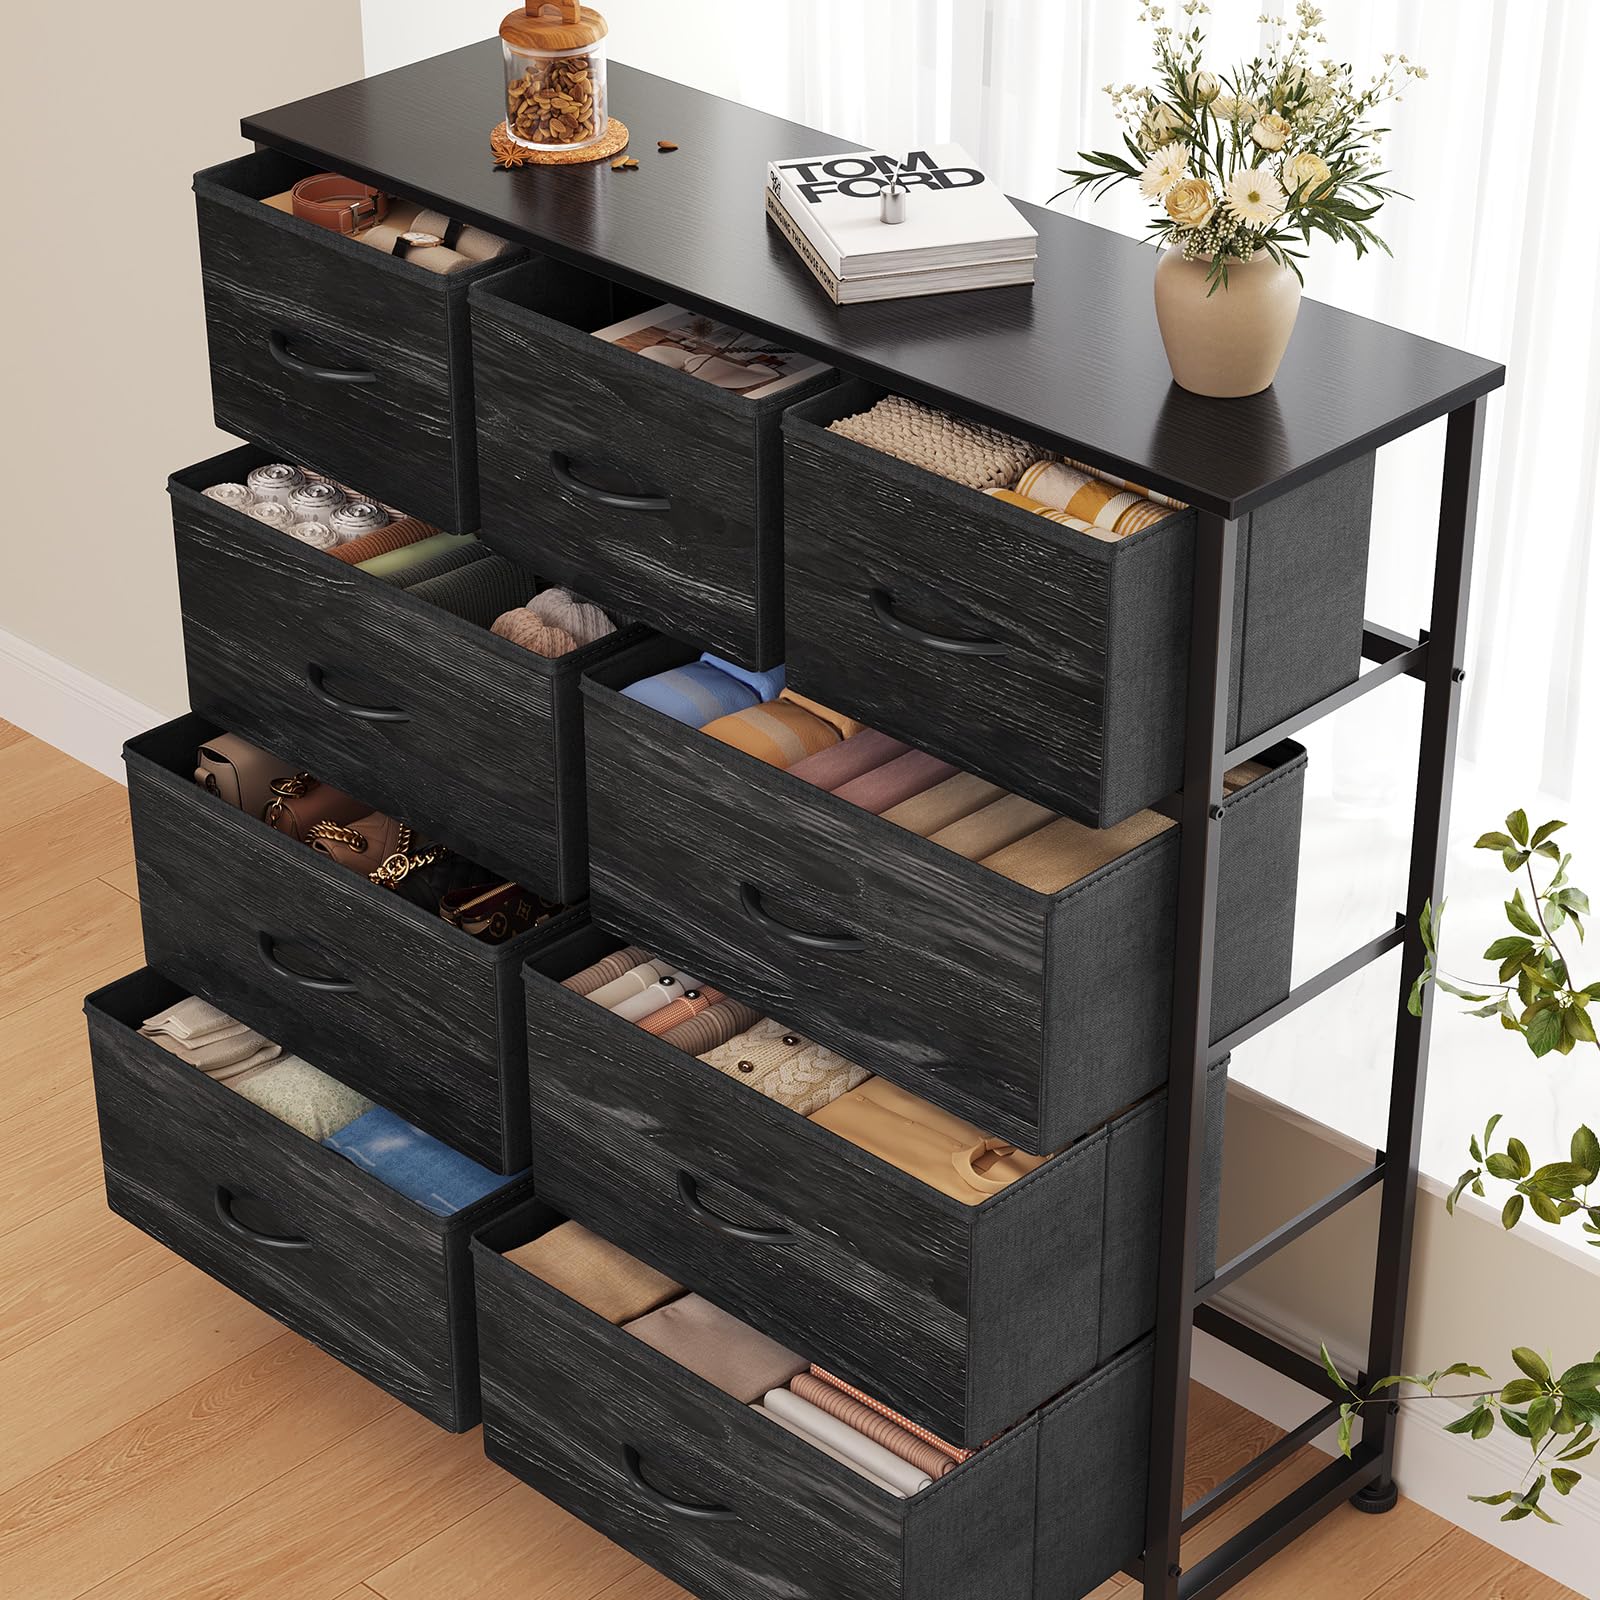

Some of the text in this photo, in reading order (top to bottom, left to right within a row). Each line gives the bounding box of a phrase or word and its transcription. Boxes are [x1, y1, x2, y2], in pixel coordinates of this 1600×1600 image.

[779, 150, 939, 183] TOM
[796, 167, 985, 203] FORD
[767, 196, 791, 234] BRINGING
[791, 228, 802, 249] THE
[801, 243, 819, 272] HOUSE
[819, 265, 835, 293] HOME
